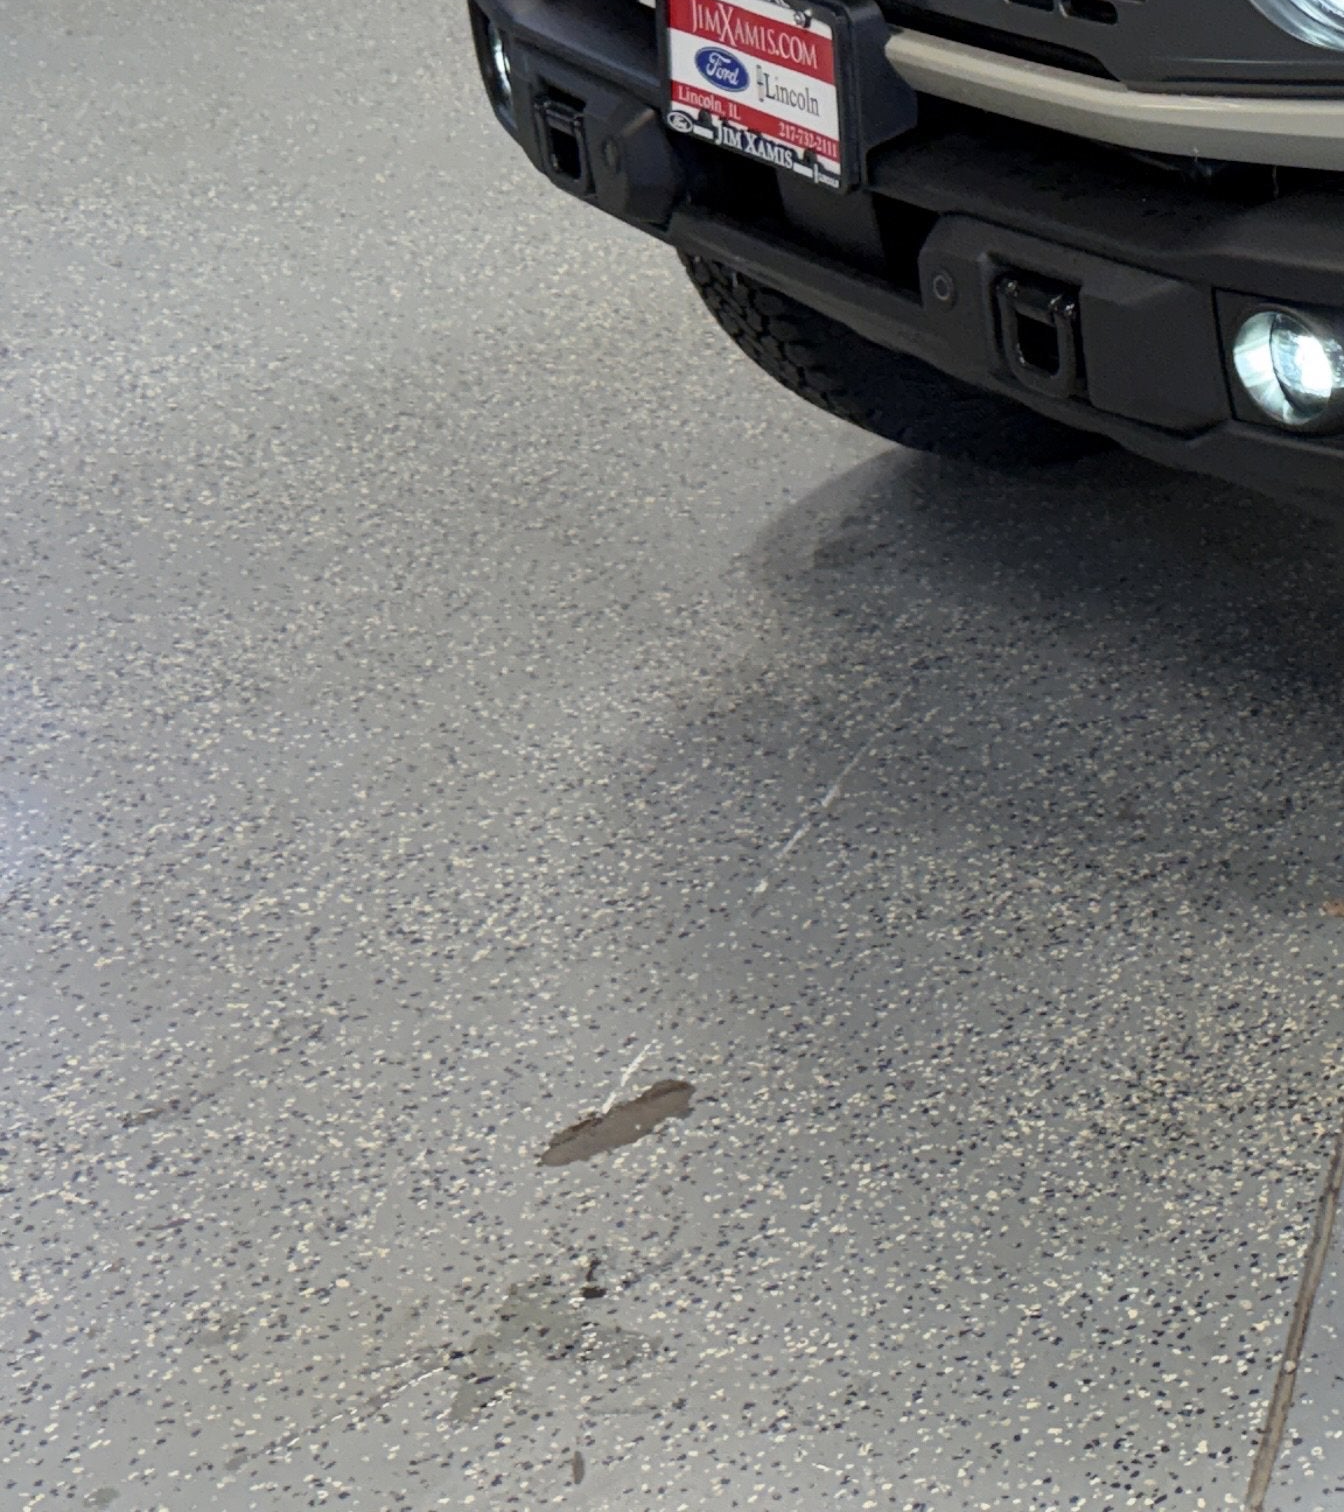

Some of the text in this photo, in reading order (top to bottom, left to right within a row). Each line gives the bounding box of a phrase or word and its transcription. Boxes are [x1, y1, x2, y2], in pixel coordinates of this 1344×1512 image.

[706, 52, 739, 86] Ford
[678, 85, 742, 120] Lincoln, IL
[764, 73, 820, 117] Lincoln
[714, 119, 743, 152] JIM
[745, 132, 793, 169] XAMIS
